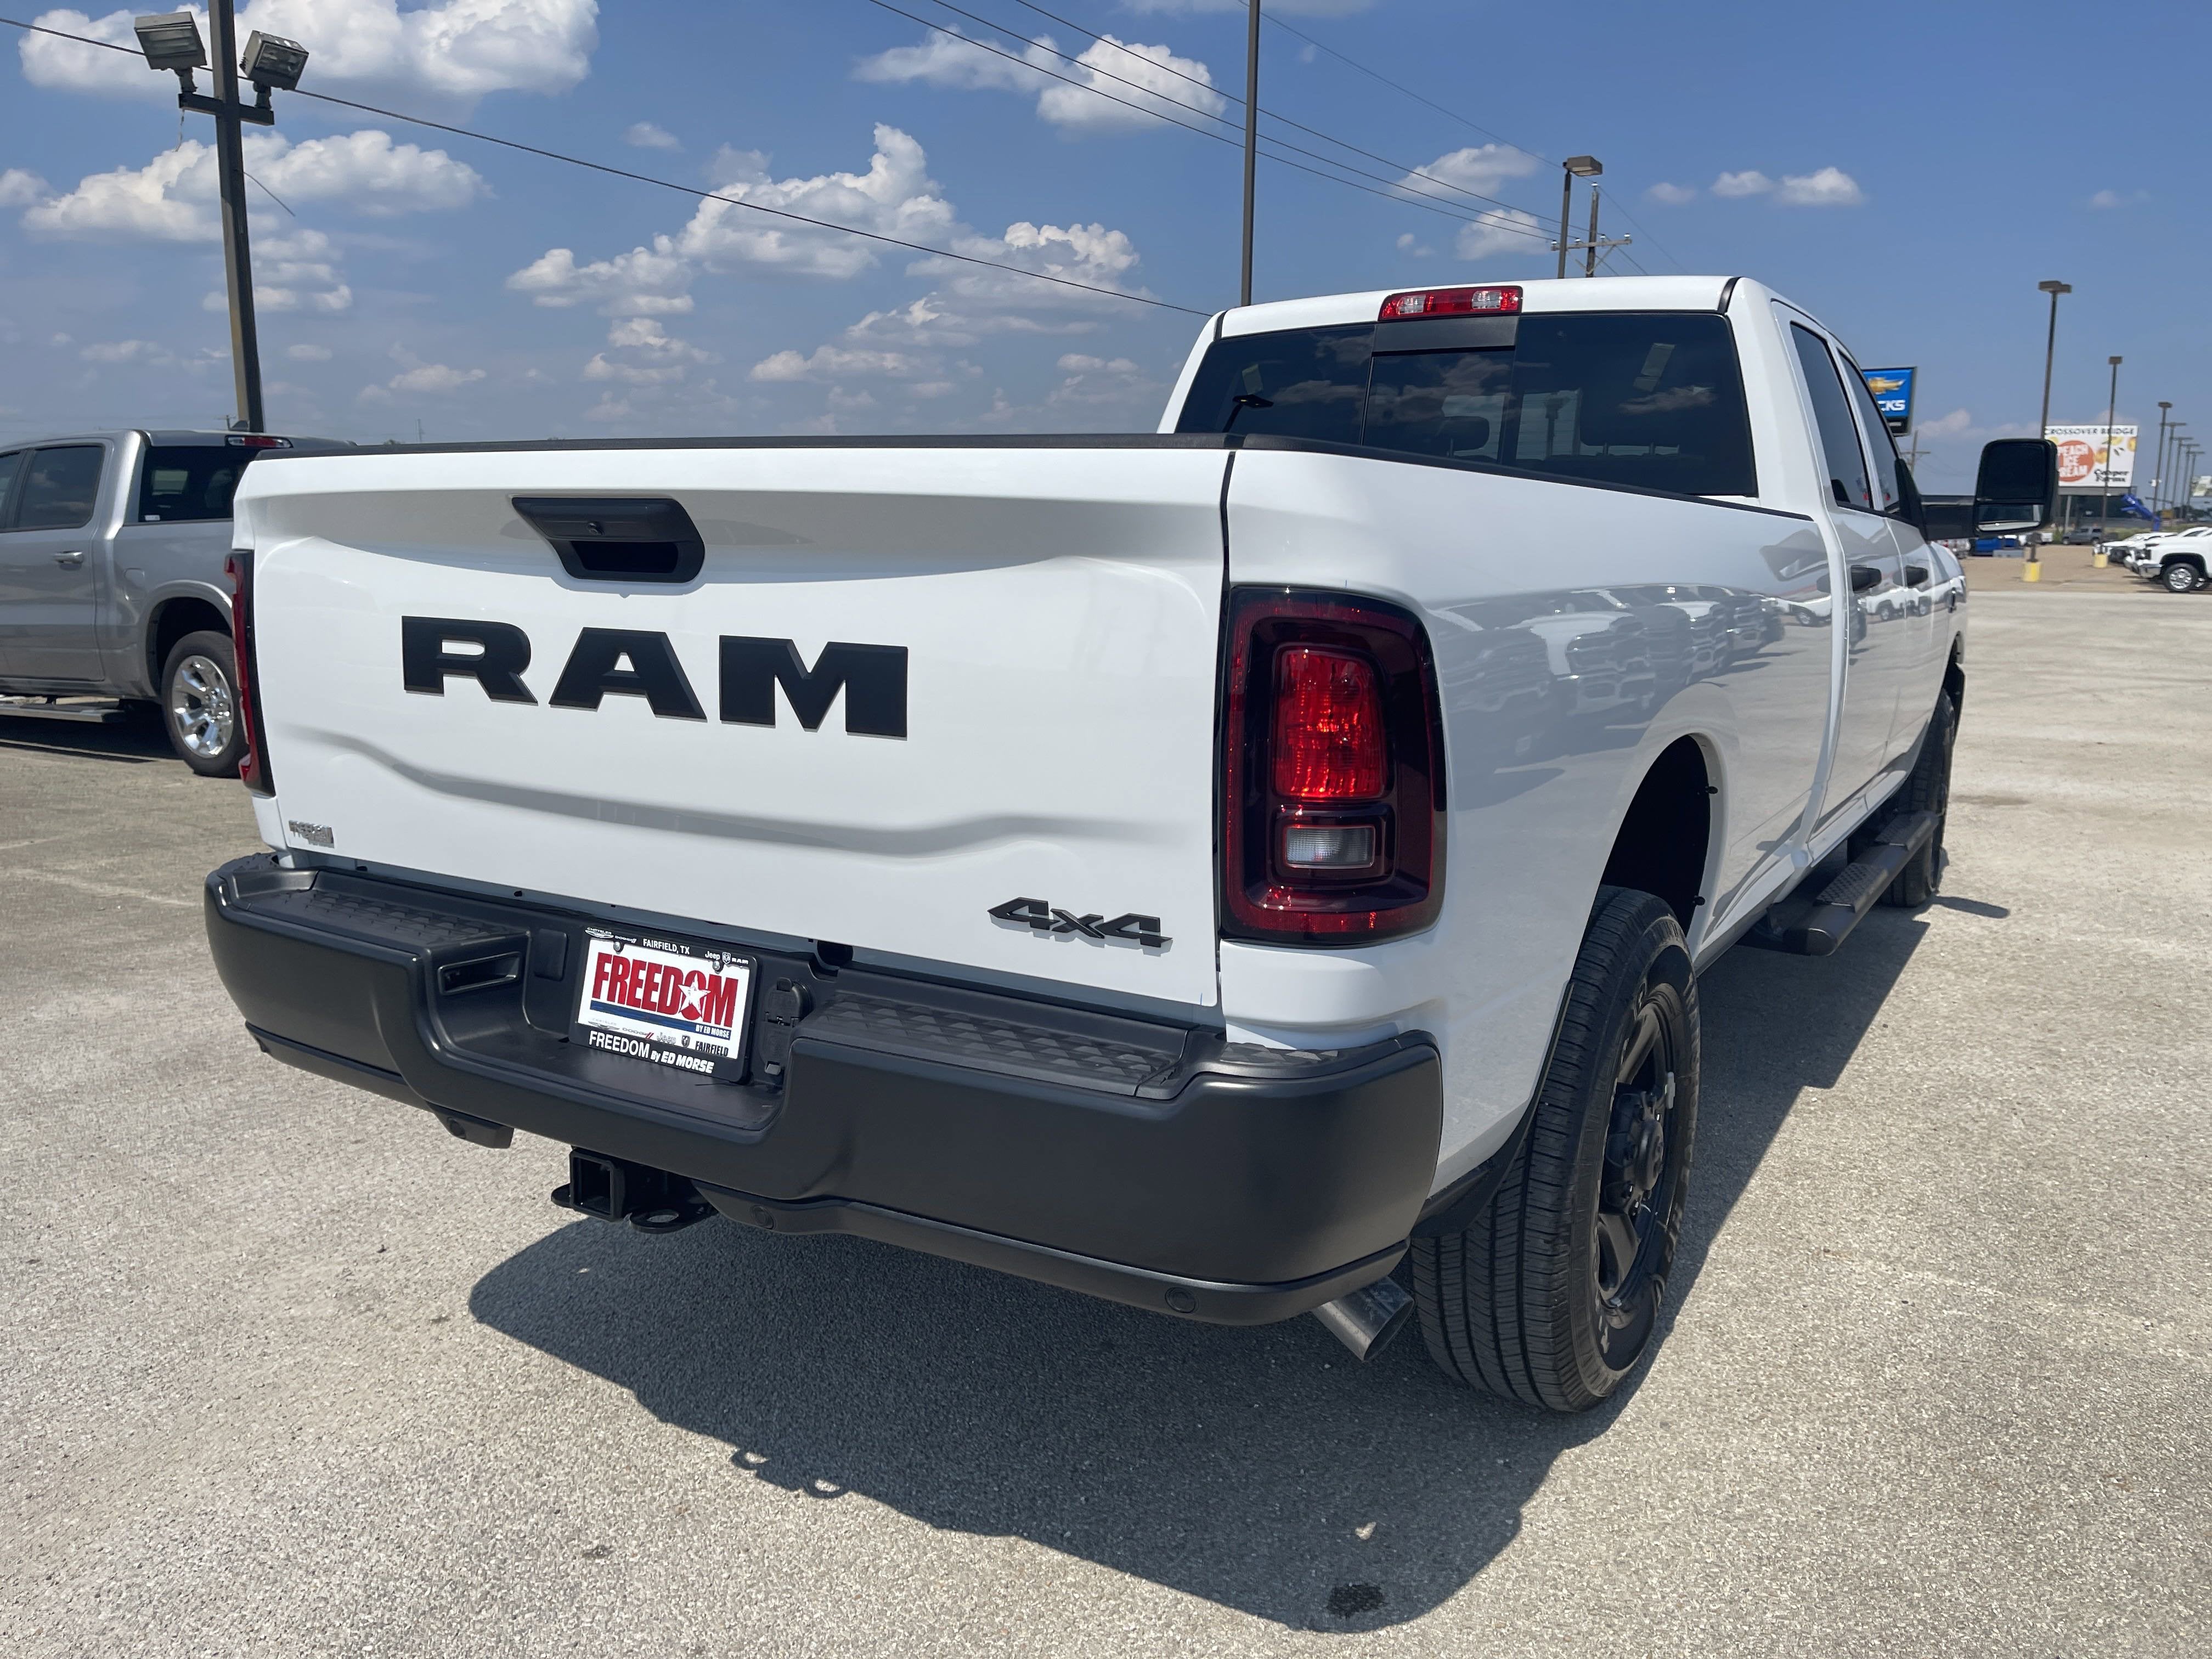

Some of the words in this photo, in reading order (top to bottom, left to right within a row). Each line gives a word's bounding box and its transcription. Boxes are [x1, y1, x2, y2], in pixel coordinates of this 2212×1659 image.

[1877, 400, 1905, 411] CKS
[2063, 455, 2079, 466] ICE
[2058, 465, 2087, 477] REAM
[402, 616, 908, 737] RAM
[987, 897, 1173, 948] 4x4
[643, 939, 679, 953] FAIRFIELD,
[680, 945, 690, 955] TX
[705, 951, 720, 960] Jeep
[592, 952, 738, 1028] FREEDOM
[711, 1028, 730, 1038] MORSE
[589, 1030, 650, 1058] FREEDOM
[661, 1051, 675, 1064] ED
[675, 1054, 714, 1074] MORSE
[657, 1032, 676, 1045] Jeep
[695, 1041, 729, 1056] FAIRFIELD
